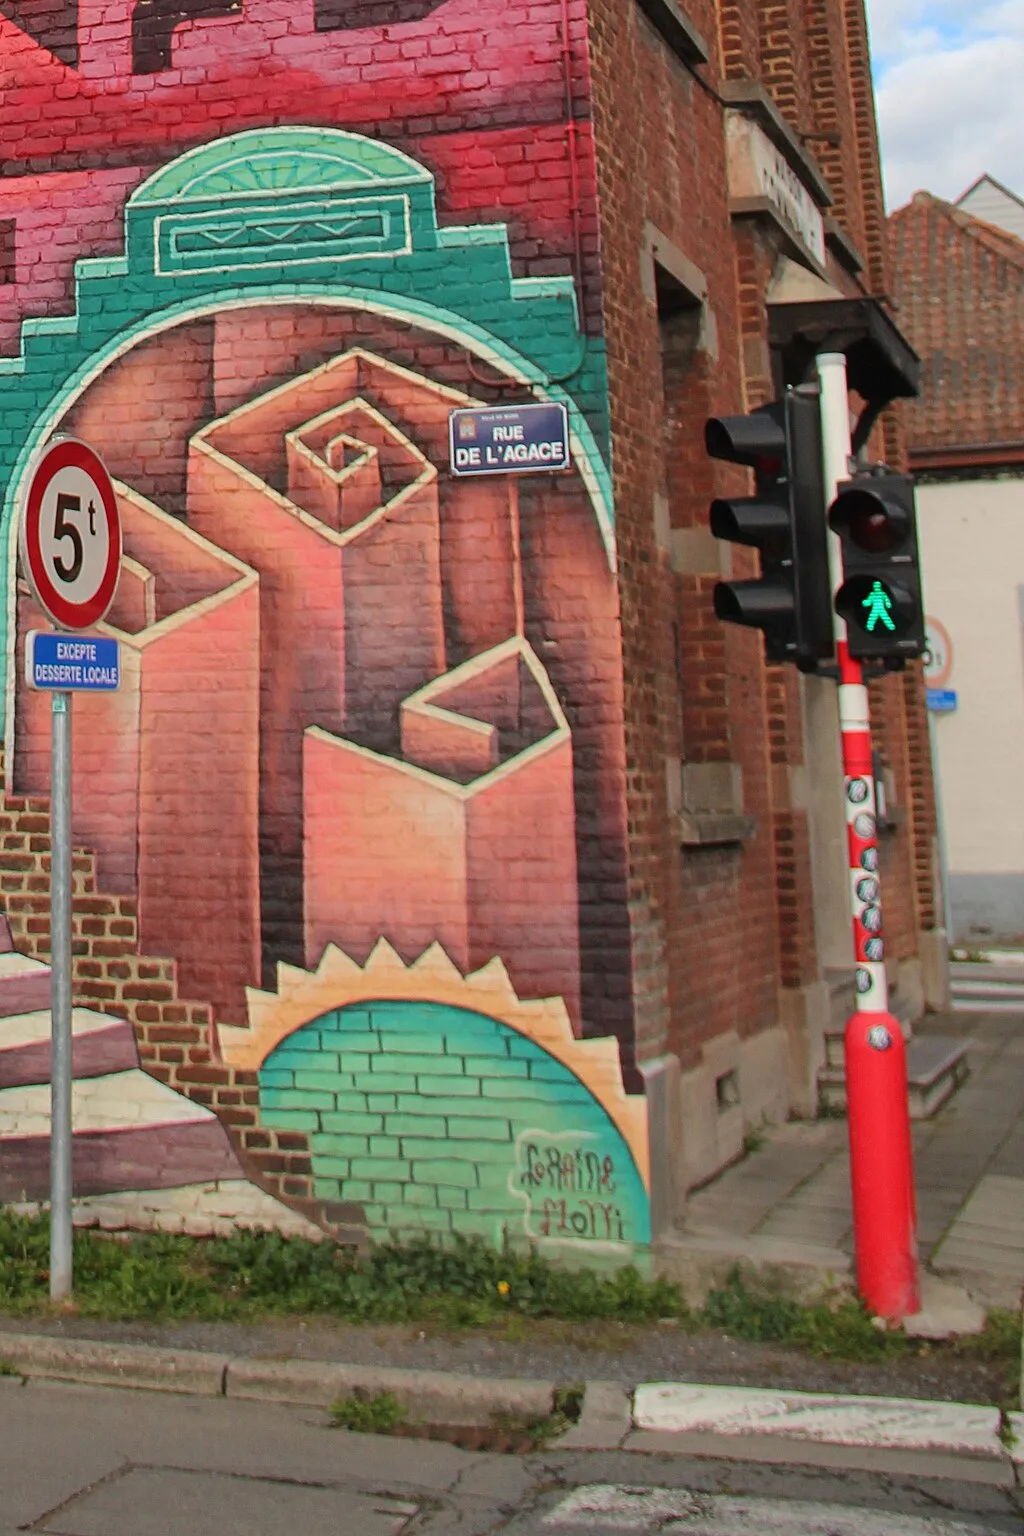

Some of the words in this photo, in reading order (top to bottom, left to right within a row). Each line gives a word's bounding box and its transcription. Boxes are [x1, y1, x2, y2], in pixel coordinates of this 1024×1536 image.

[492, 425, 524, 442] RUE
[455, 447, 482, 467] DE
[485, 441, 564, 465] L'AGACE
[57, 642, 97, 662] EXCEPTE
[35, 663, 82, 684] DESSERTE
[83, 665, 118, 685] LOCALE
